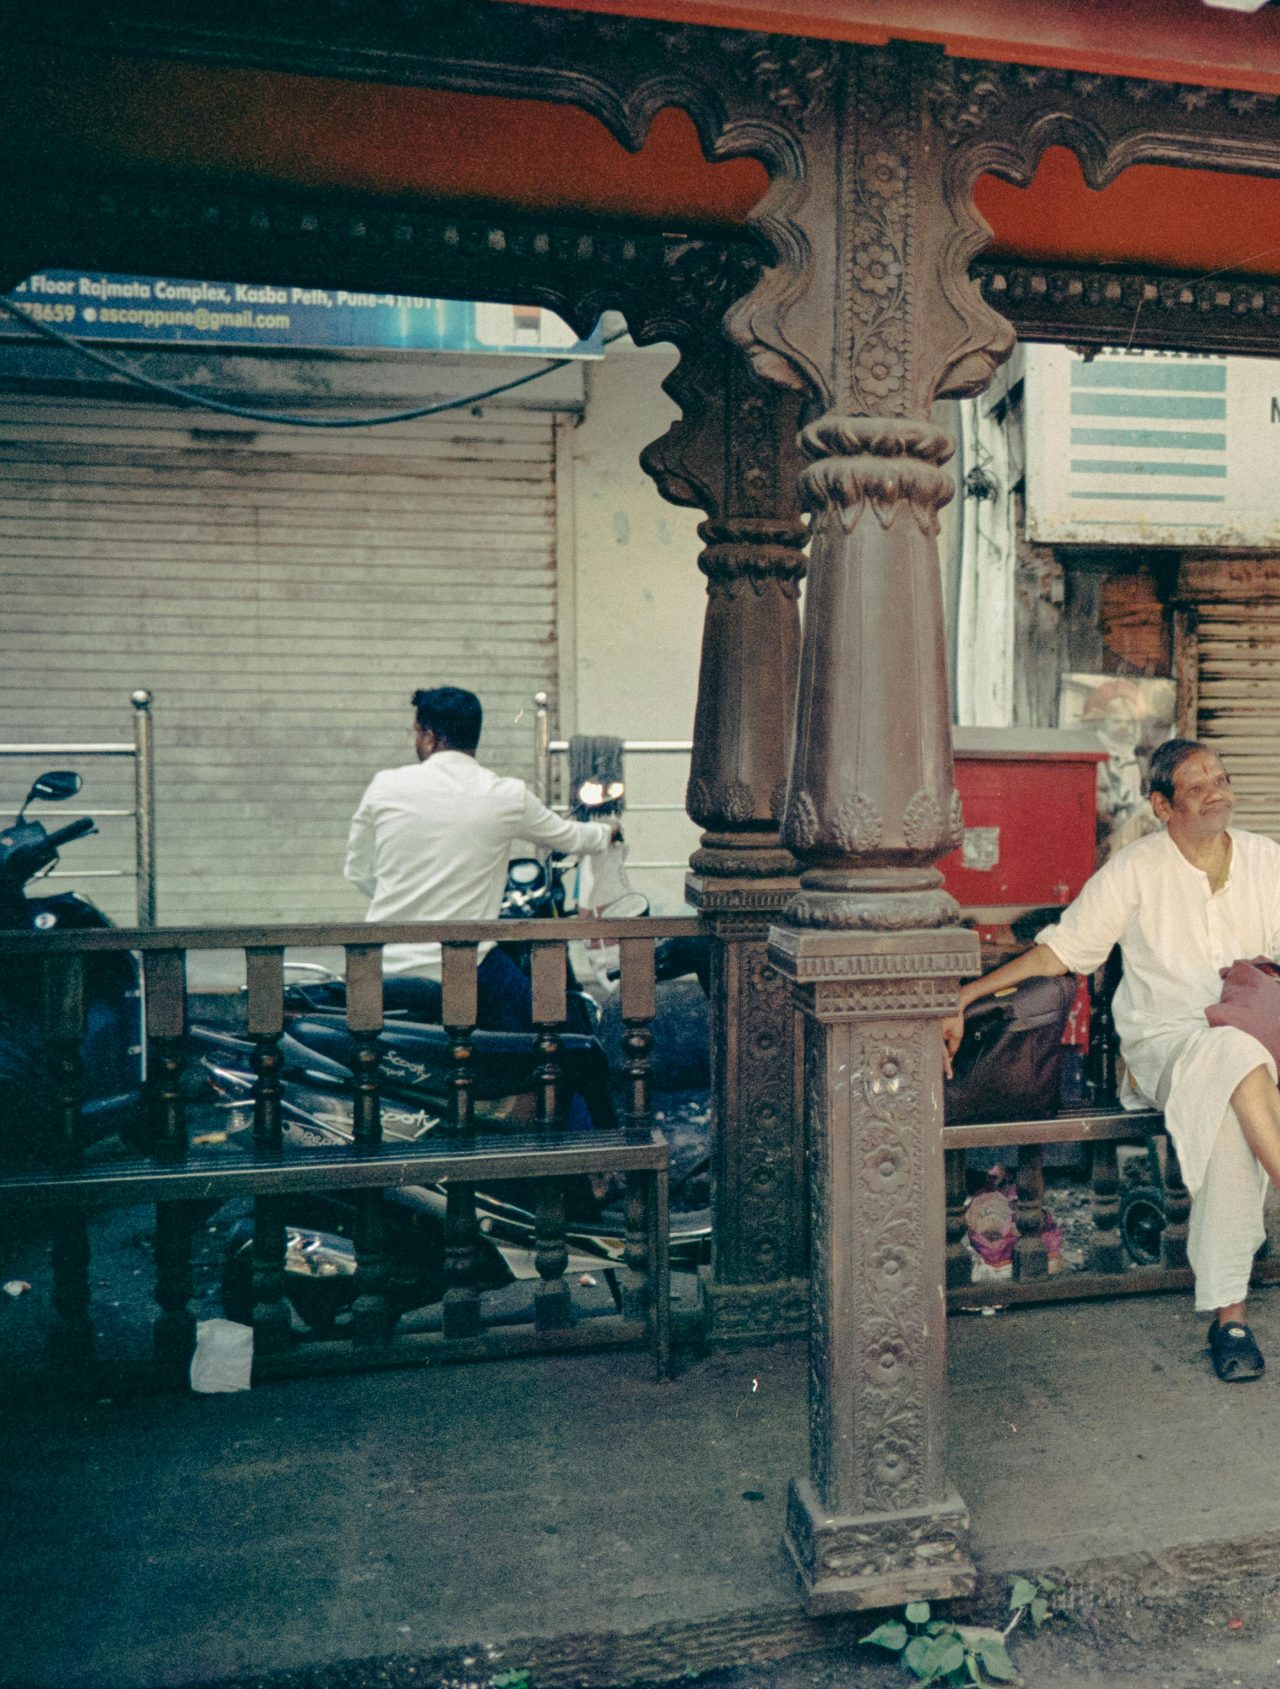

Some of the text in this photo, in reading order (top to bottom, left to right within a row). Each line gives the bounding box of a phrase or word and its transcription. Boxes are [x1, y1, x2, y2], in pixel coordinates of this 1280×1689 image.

[31, 275, 76, 295] Floor
[78, 277, 151, 300] Rajmata
[155, 280, 231, 304] Complex,
[235, 284, 288, 304] Kasba
[291, 288, 334, 308] Peth,
[100, 308, 290, 331] ascorppune@gmail.com
